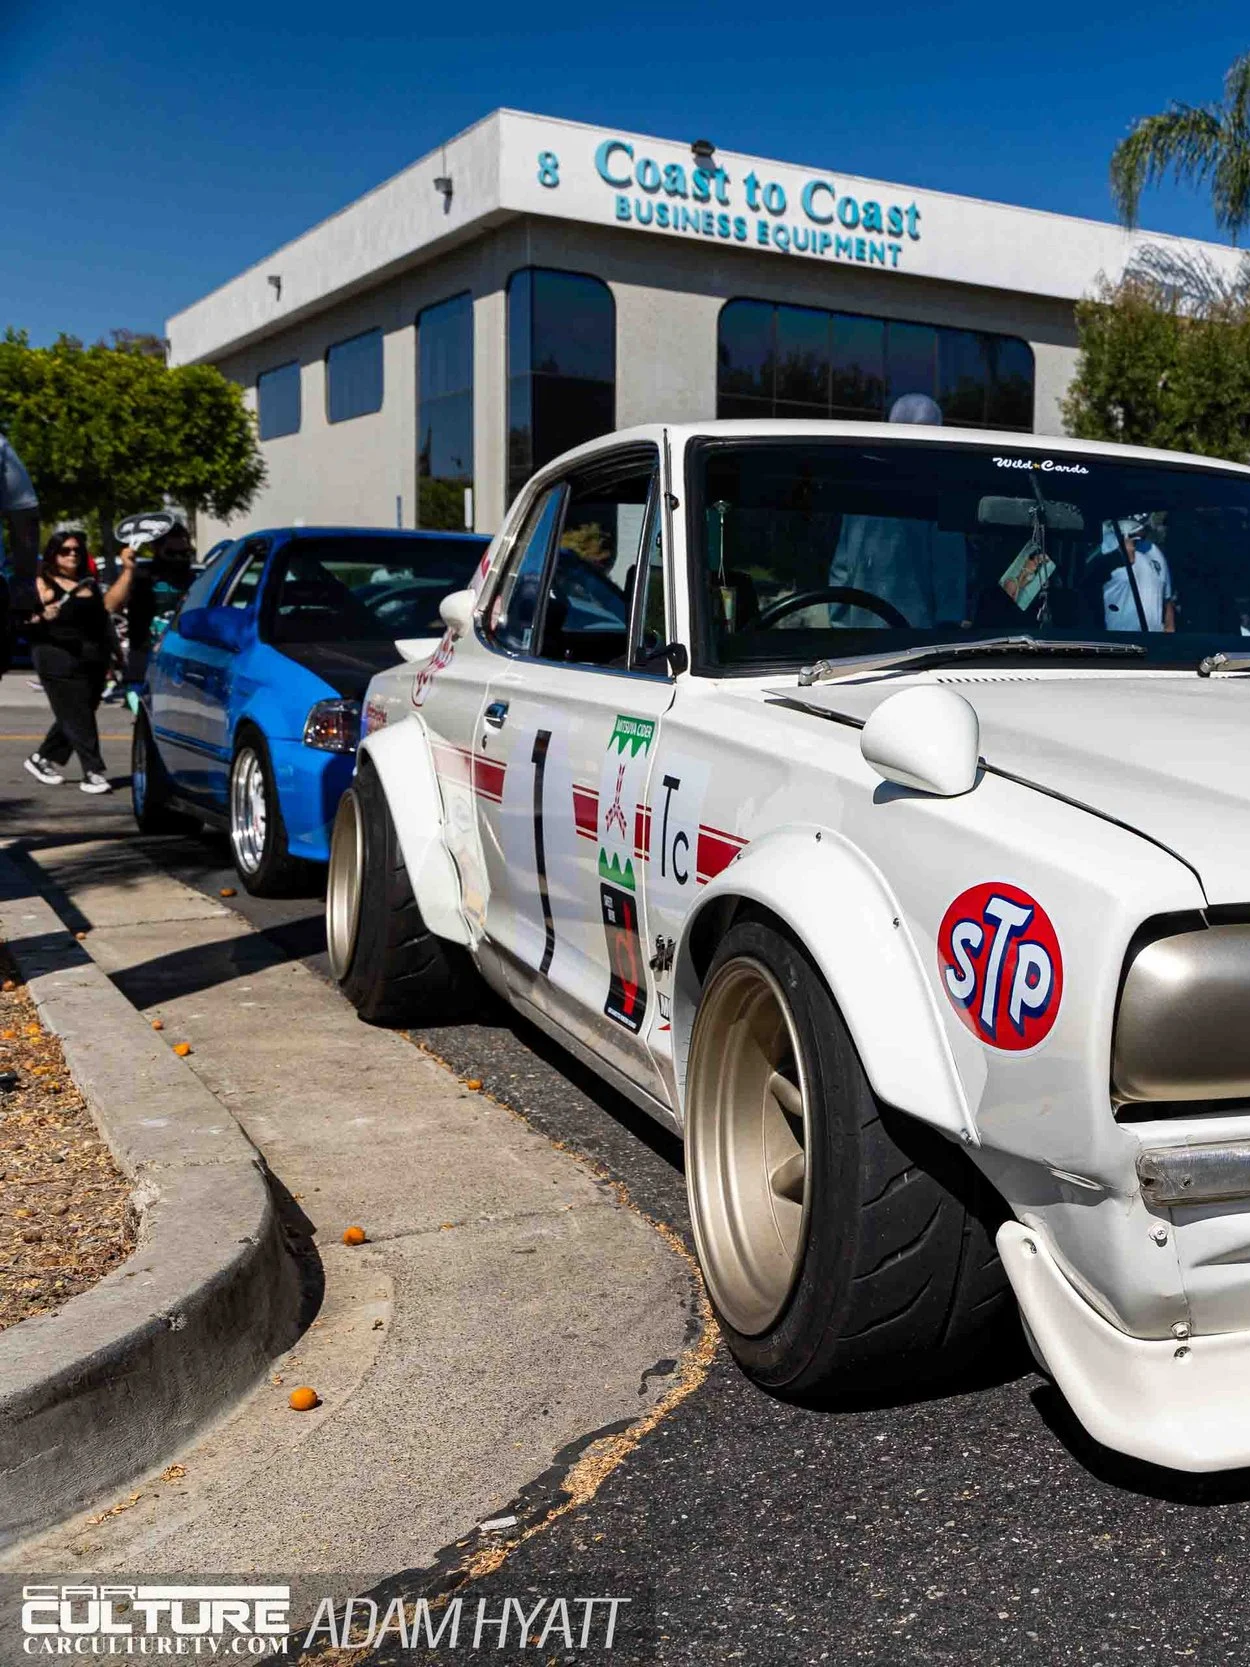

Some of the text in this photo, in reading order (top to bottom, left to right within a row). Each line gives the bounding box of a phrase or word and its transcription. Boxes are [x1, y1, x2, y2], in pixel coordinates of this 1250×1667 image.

[537, 150, 560, 188] 8
[595, 139, 921, 240] Coast to Coast
[615, 195, 903, 268] BUSINESS EQUIPMENT
[992, 457, 1089, 475] Wild Cards
[637, 723, 653, 739] CIDER
[945, 893, 1054, 1040] STP
